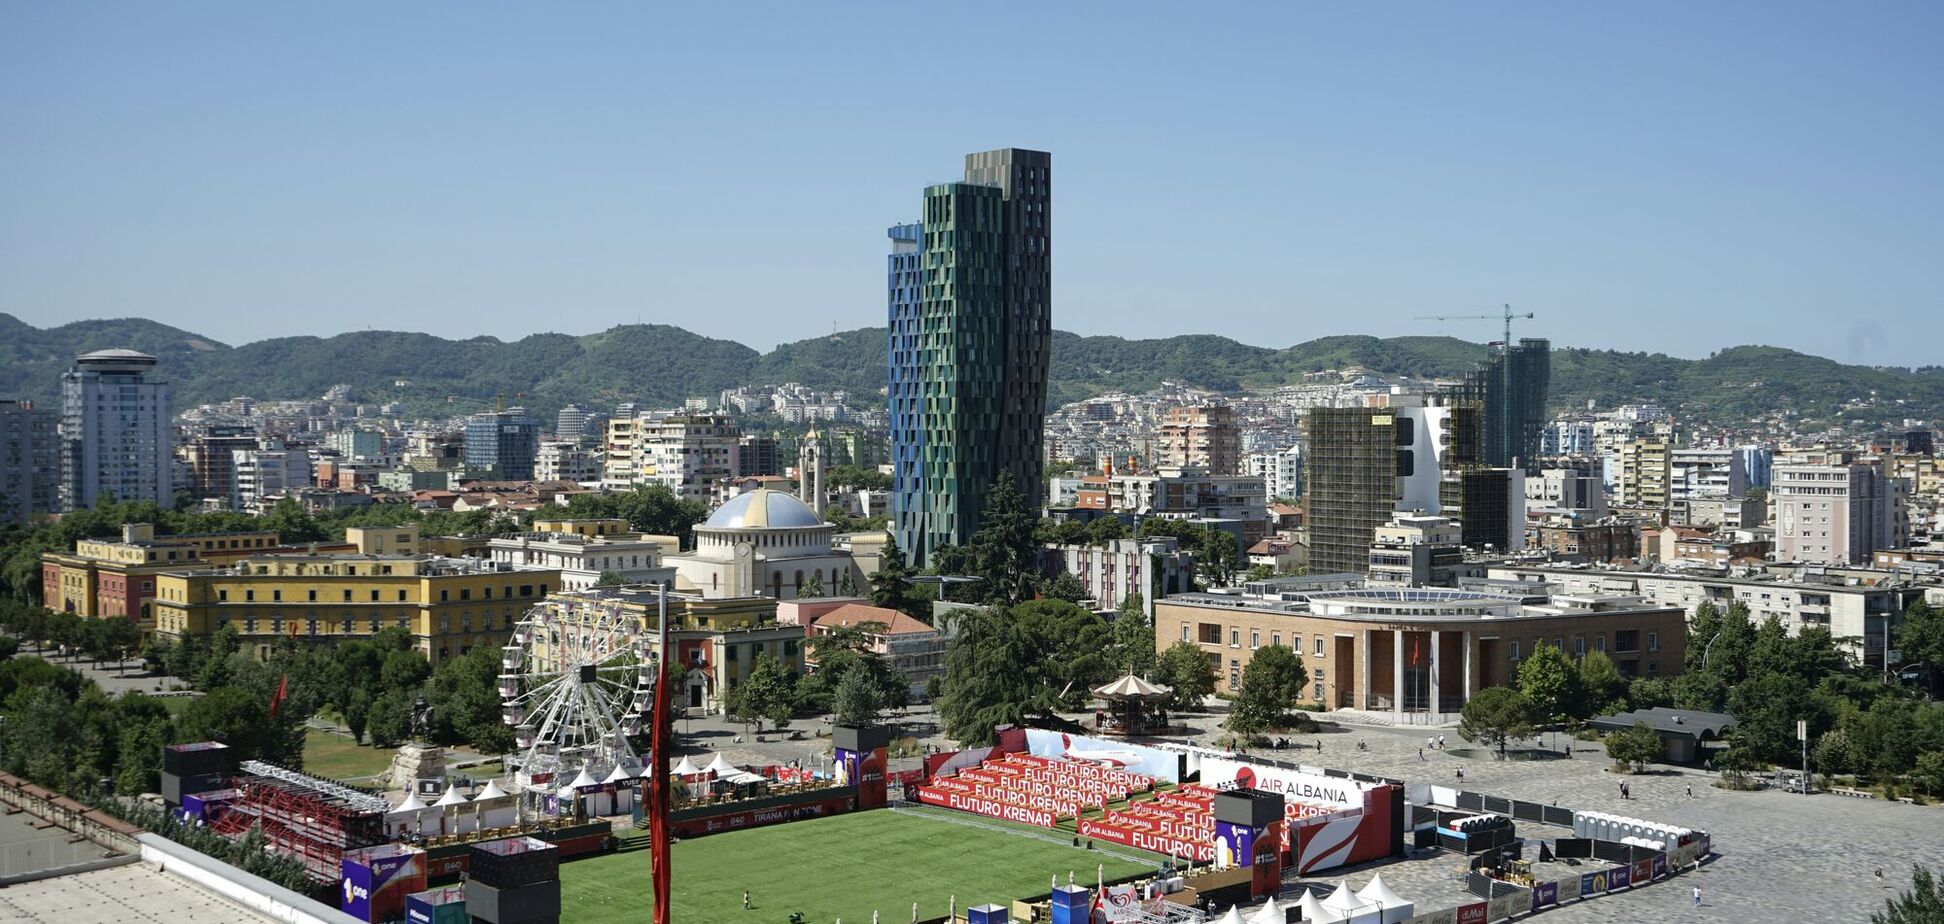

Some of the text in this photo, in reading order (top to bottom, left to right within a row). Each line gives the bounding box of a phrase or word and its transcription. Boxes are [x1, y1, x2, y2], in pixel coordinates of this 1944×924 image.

[1022, 758, 1041, 767] ALBANIA
[999, 766, 1018, 774] ALBANIA
[1048, 761, 1150, 788] FLUTURO KRENAR
[976, 774, 994, 783] ALBANIA
[1025, 768, 1128, 798] FLUTURO KRENAR
[949, 782, 969, 791] ALBANIA
[1001, 776, 1102, 808] FLUTURO KRENAR
[1260, 778, 1348, 804] AIR ALBANIA
[924, 791, 944, 800] ALBANIA
[976, 784, 1078, 816] FLUTURO KRENAR
[1200, 790, 1215, 800] ALBA
[950, 794, 1052, 827] FLUTURO KRENAR
[1176, 800, 1200, 809] ALBANIA
[754, 810, 782, 822] TIRANA
[784, 808, 800, 818] FN
[1152, 808, 1176, 818] ALBANIA
[1118, 816, 1152, 830] AIR ALBANIA
[1184, 812, 1216, 830] FLUT
[1100, 828, 1124, 840] ALBANIA
[1132, 832, 1194, 858] FLUTURO
[353, 886, 368, 900] one
[1544, 888, 1554, 897] one
